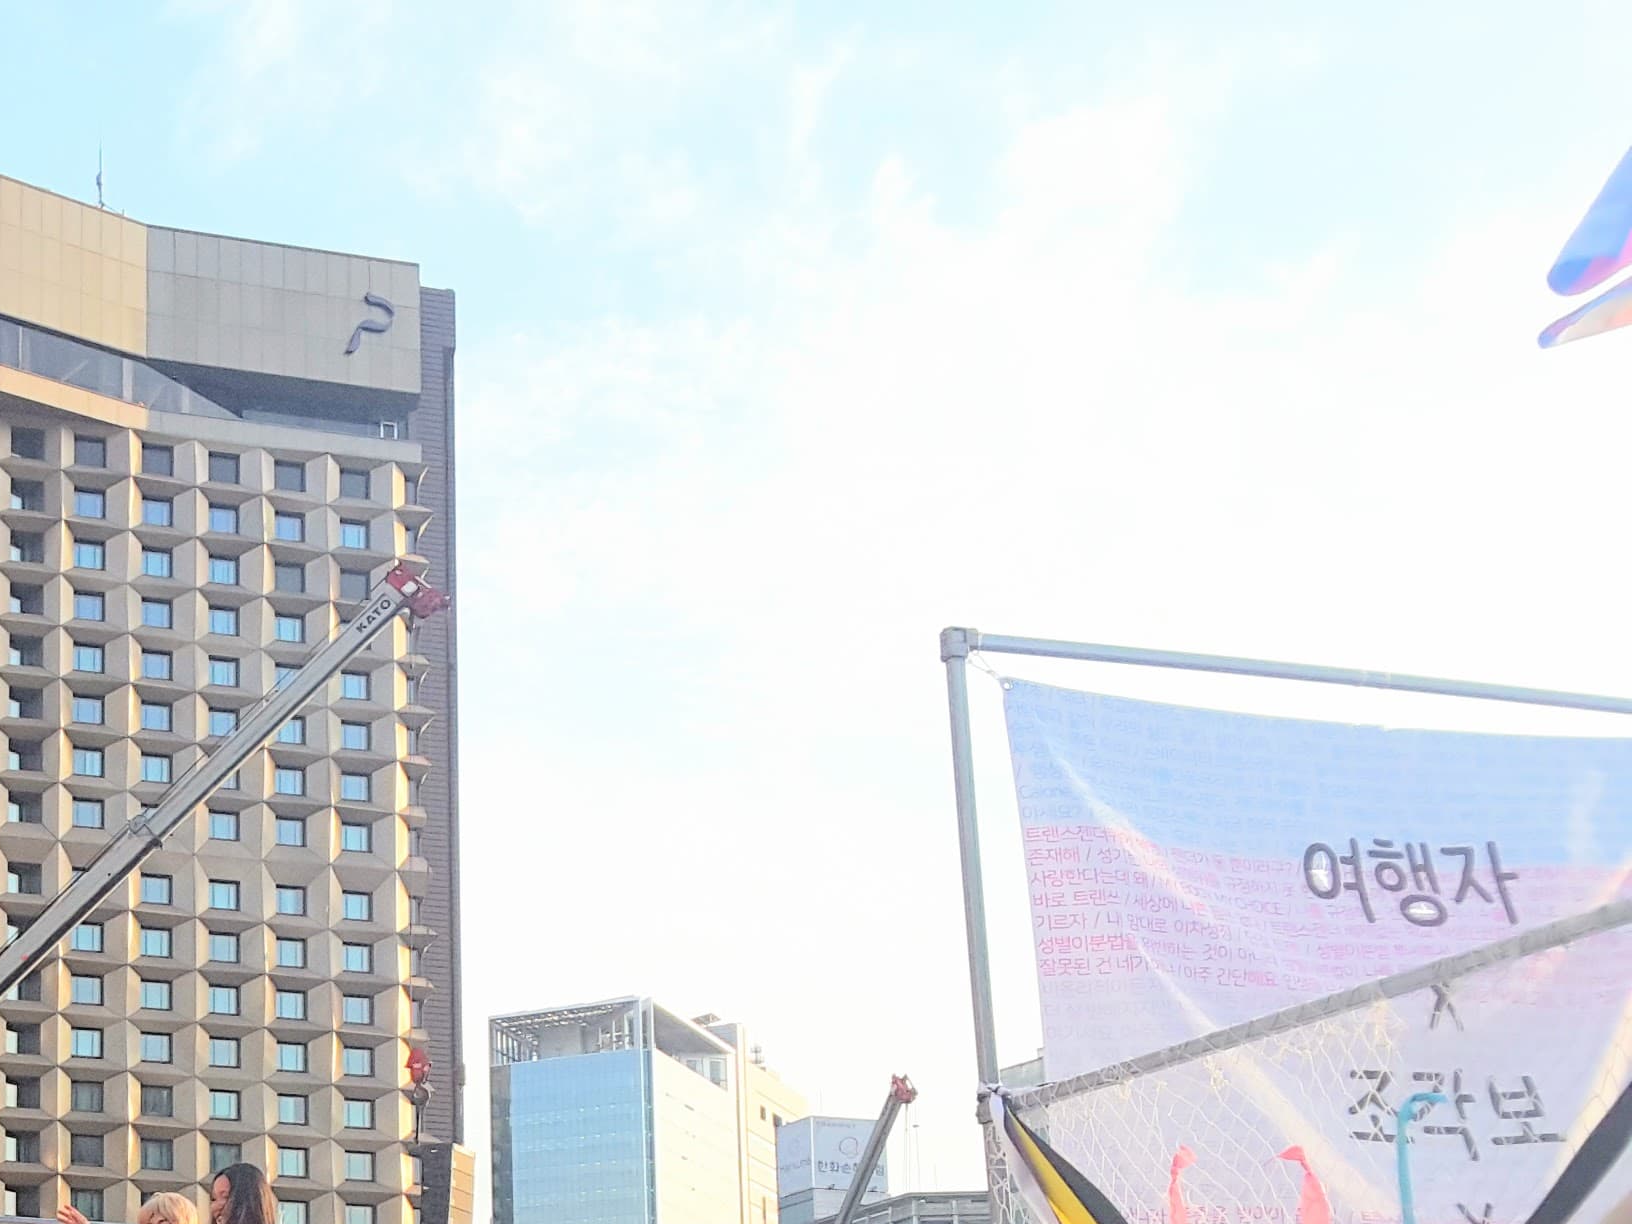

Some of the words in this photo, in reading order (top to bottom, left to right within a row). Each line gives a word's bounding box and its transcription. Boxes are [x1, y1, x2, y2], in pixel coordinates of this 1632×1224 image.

[356, 599, 391, 633] KATO
[1302, 836, 1520, 927] 여행자
[1347, 1066, 1568, 1163] 조각보
